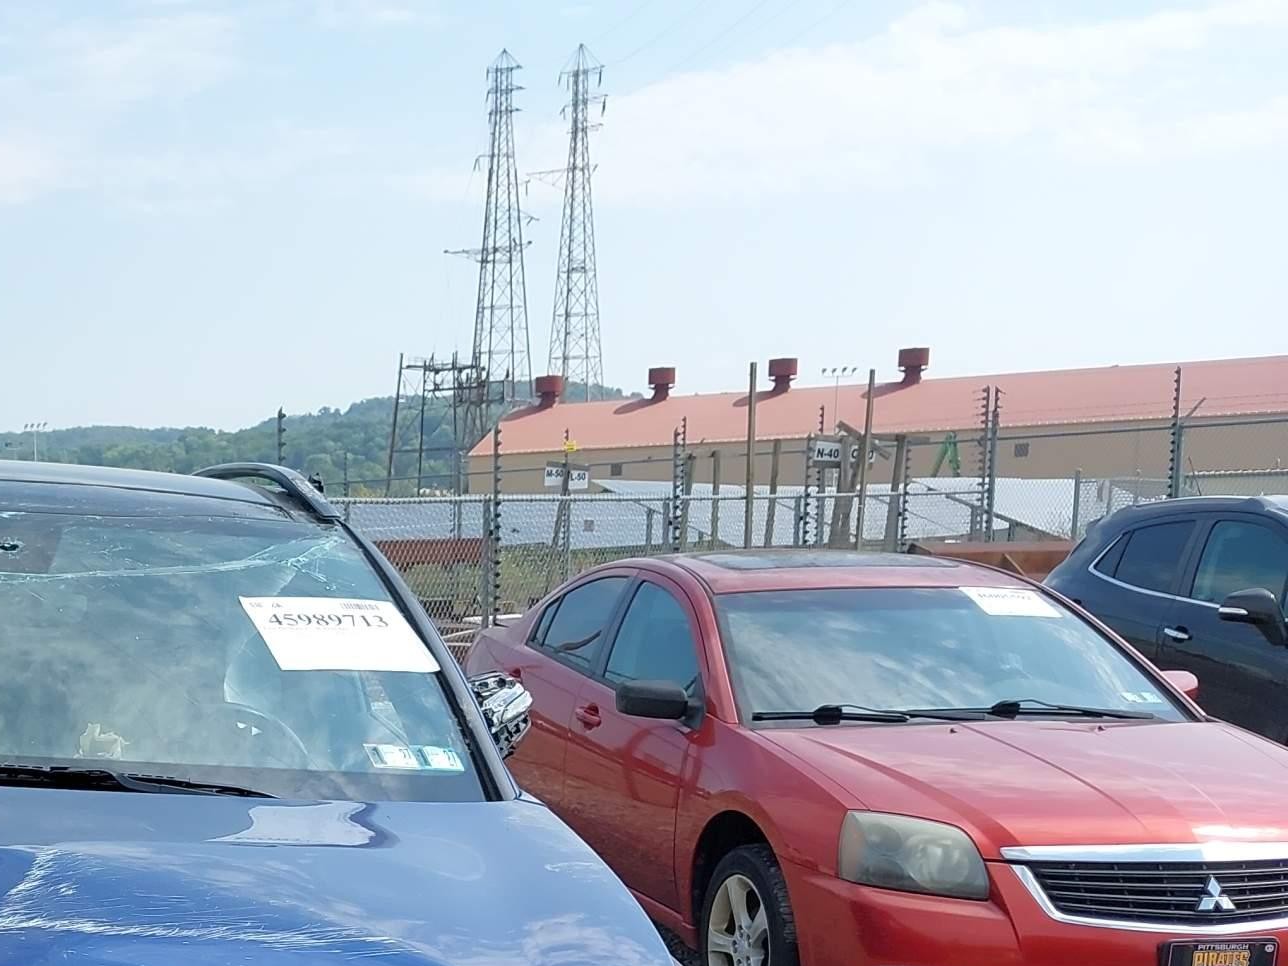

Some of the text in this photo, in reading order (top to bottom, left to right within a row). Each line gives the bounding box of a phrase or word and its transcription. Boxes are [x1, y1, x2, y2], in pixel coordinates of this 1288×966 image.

[816, 447, 840, 459] N-40
[570, 472, 586, 481] L-50
[268, 613, 389, 628] 45989713
